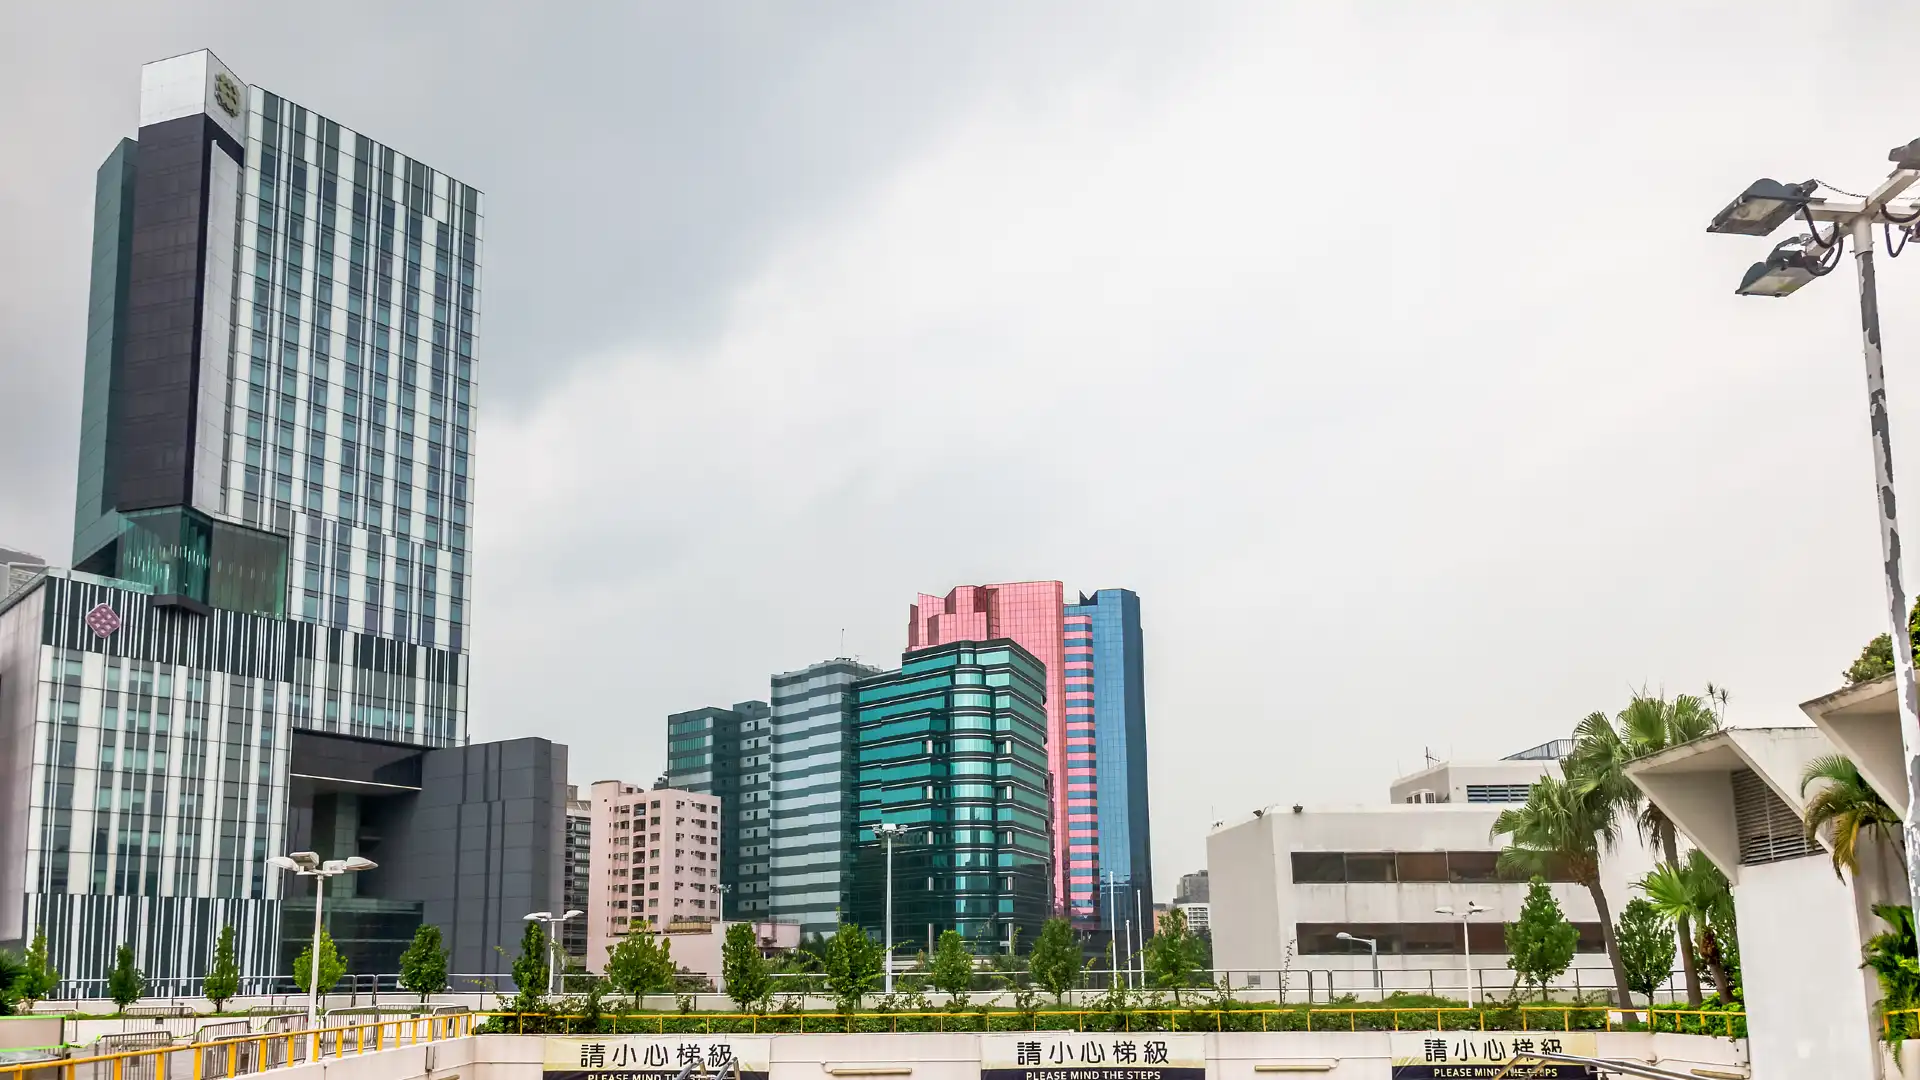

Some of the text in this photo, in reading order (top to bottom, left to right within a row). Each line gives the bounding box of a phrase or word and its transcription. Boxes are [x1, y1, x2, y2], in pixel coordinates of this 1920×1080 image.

[581, 1043, 732, 1068] 請小心梯級
[1017, 1040, 1169, 1066] 請小心梯級
[1424, 1038, 1563, 1062] 請小心梯級
[1026, 1071, 1161, 1080] PLEASE MIND THE STEPS
[1434, 1068, 1472, 1077] PLEASE
